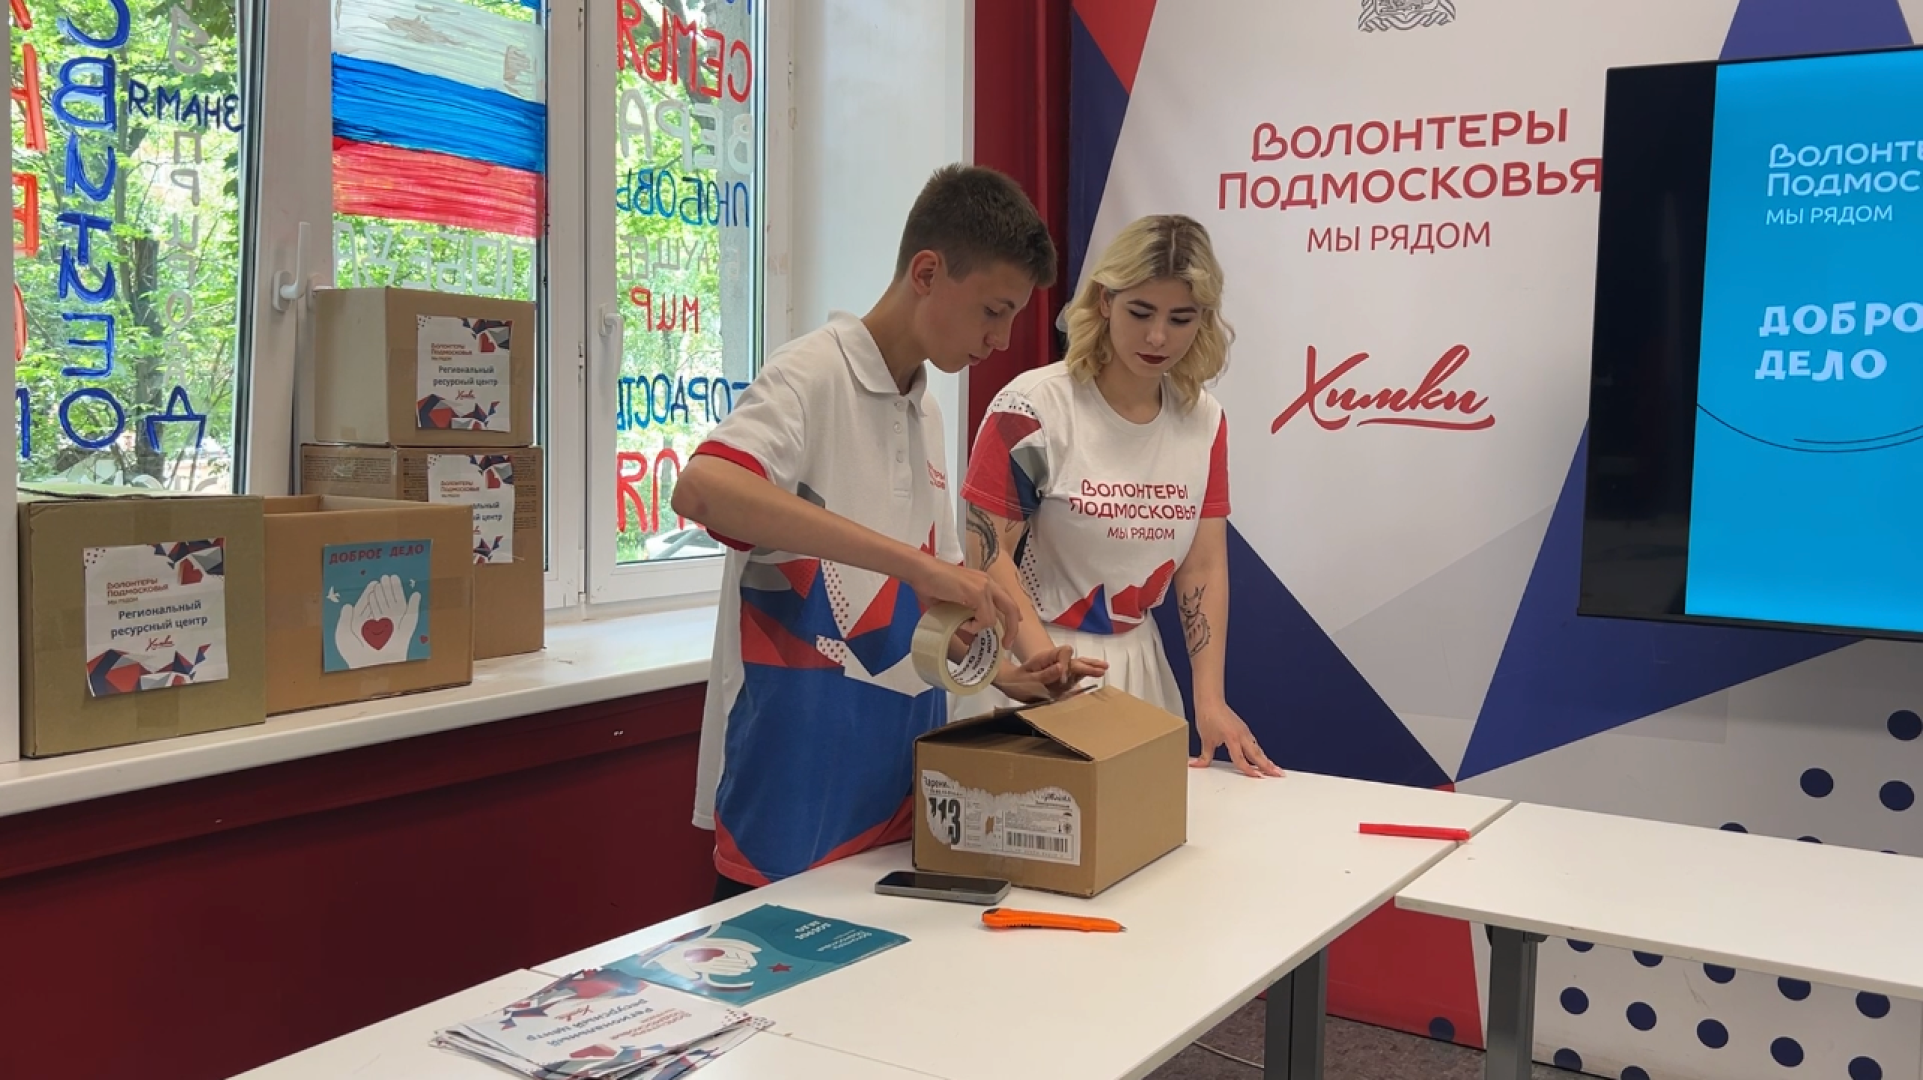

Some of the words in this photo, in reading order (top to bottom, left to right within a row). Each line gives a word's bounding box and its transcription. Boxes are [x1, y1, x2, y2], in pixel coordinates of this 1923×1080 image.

[1251, 108, 1568, 162] ВОЛОНТЕРЫ
[1218, 157, 1602, 210] ПОДМОСКОВЬЯ
[1766, 208, 1804, 225] МЫ
[1810, 205, 1893, 225] РЯДОМ
[1307, 226, 1360, 253] МЫ
[1370, 221, 1491, 255] РЯДОМ
[1755, 349, 1887, 381] ДЕЛО
[1271, 344, 1496, 434] Химки
[1081, 479, 1188, 499] ВОЛОНТЕРЫ
[1069, 497, 1196, 520] ПОДМОСКОВЬЯ
[1107, 527, 1128, 539] МЫ
[1131, 528, 1175, 540] РЯДОМ
[118, 600, 202, 620] Региональный
[111, 619, 173, 639] ресурсный
[175, 616, 208, 630] центр
